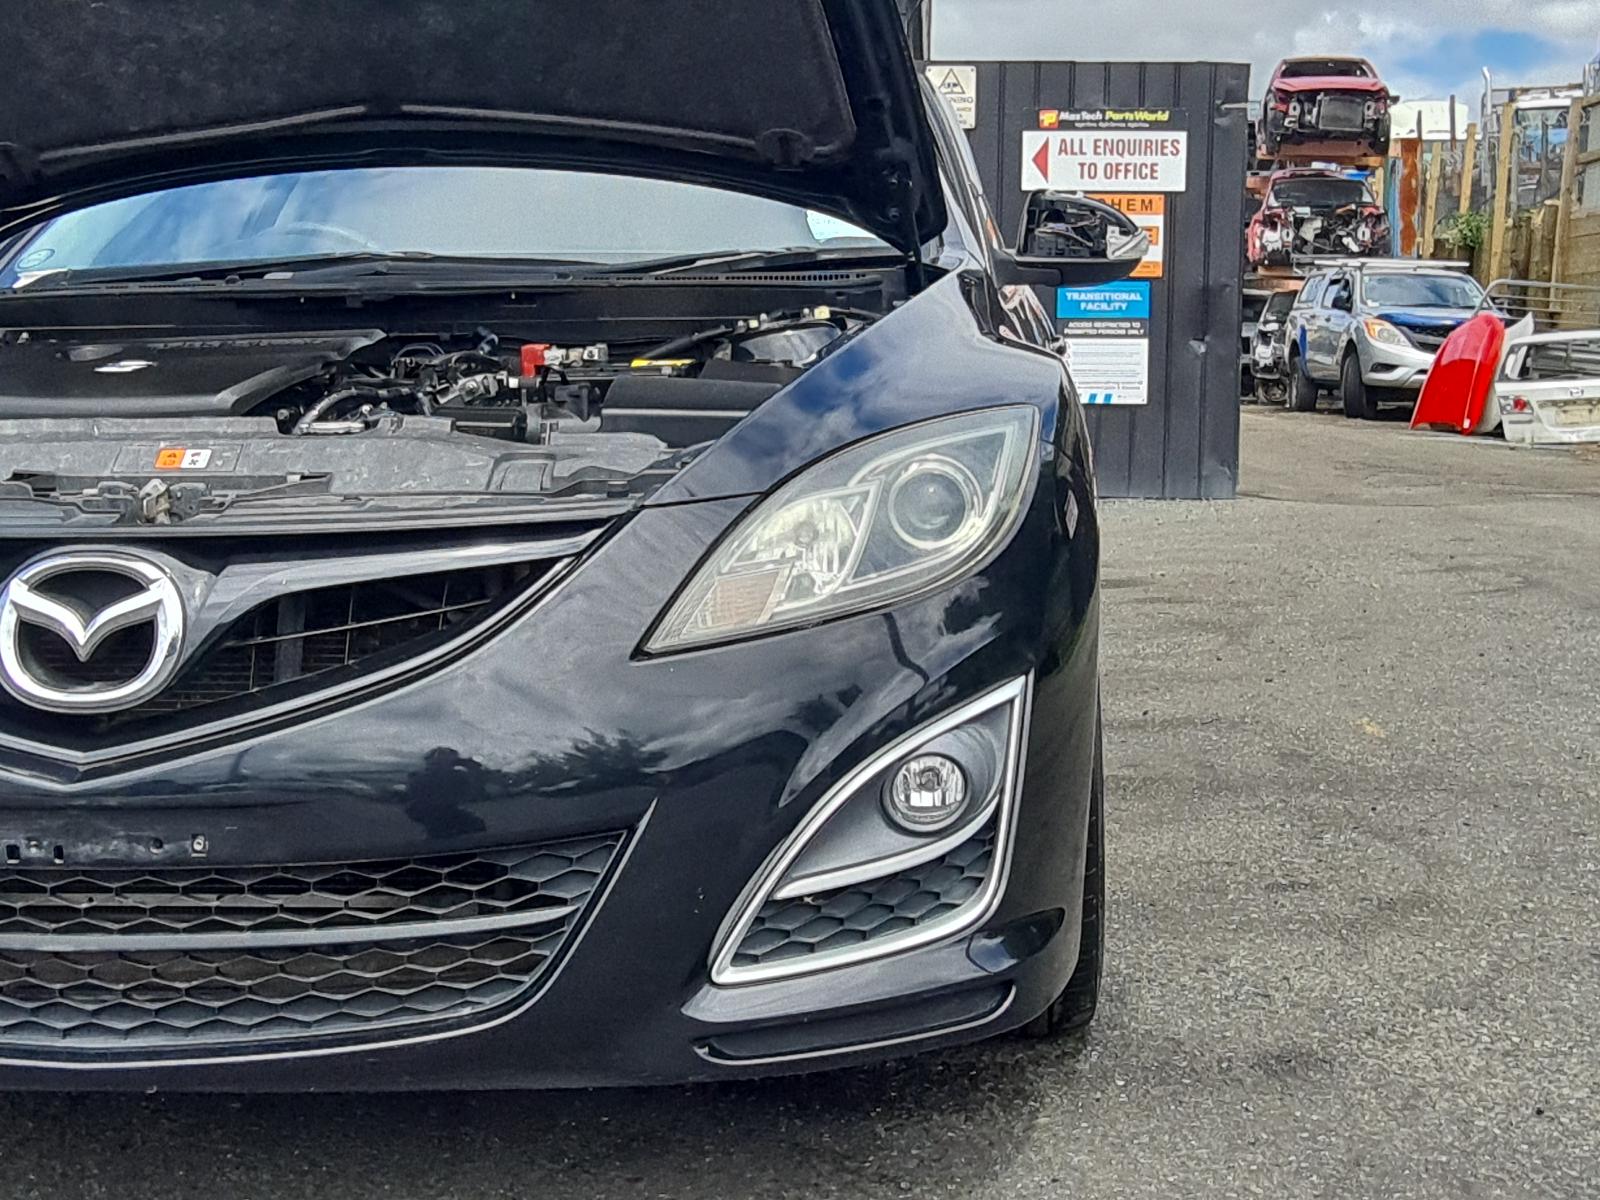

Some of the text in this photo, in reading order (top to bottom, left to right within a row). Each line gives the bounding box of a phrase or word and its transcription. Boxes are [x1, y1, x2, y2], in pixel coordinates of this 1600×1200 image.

[1058, 138, 1181, 158] ALL ENQUIRIES
[1078, 162, 1159, 180] TO OFFICE
[1065, 291, 1143, 301] TRANSITIONAL
[1080, 302, 1128, 311] FACILITY
